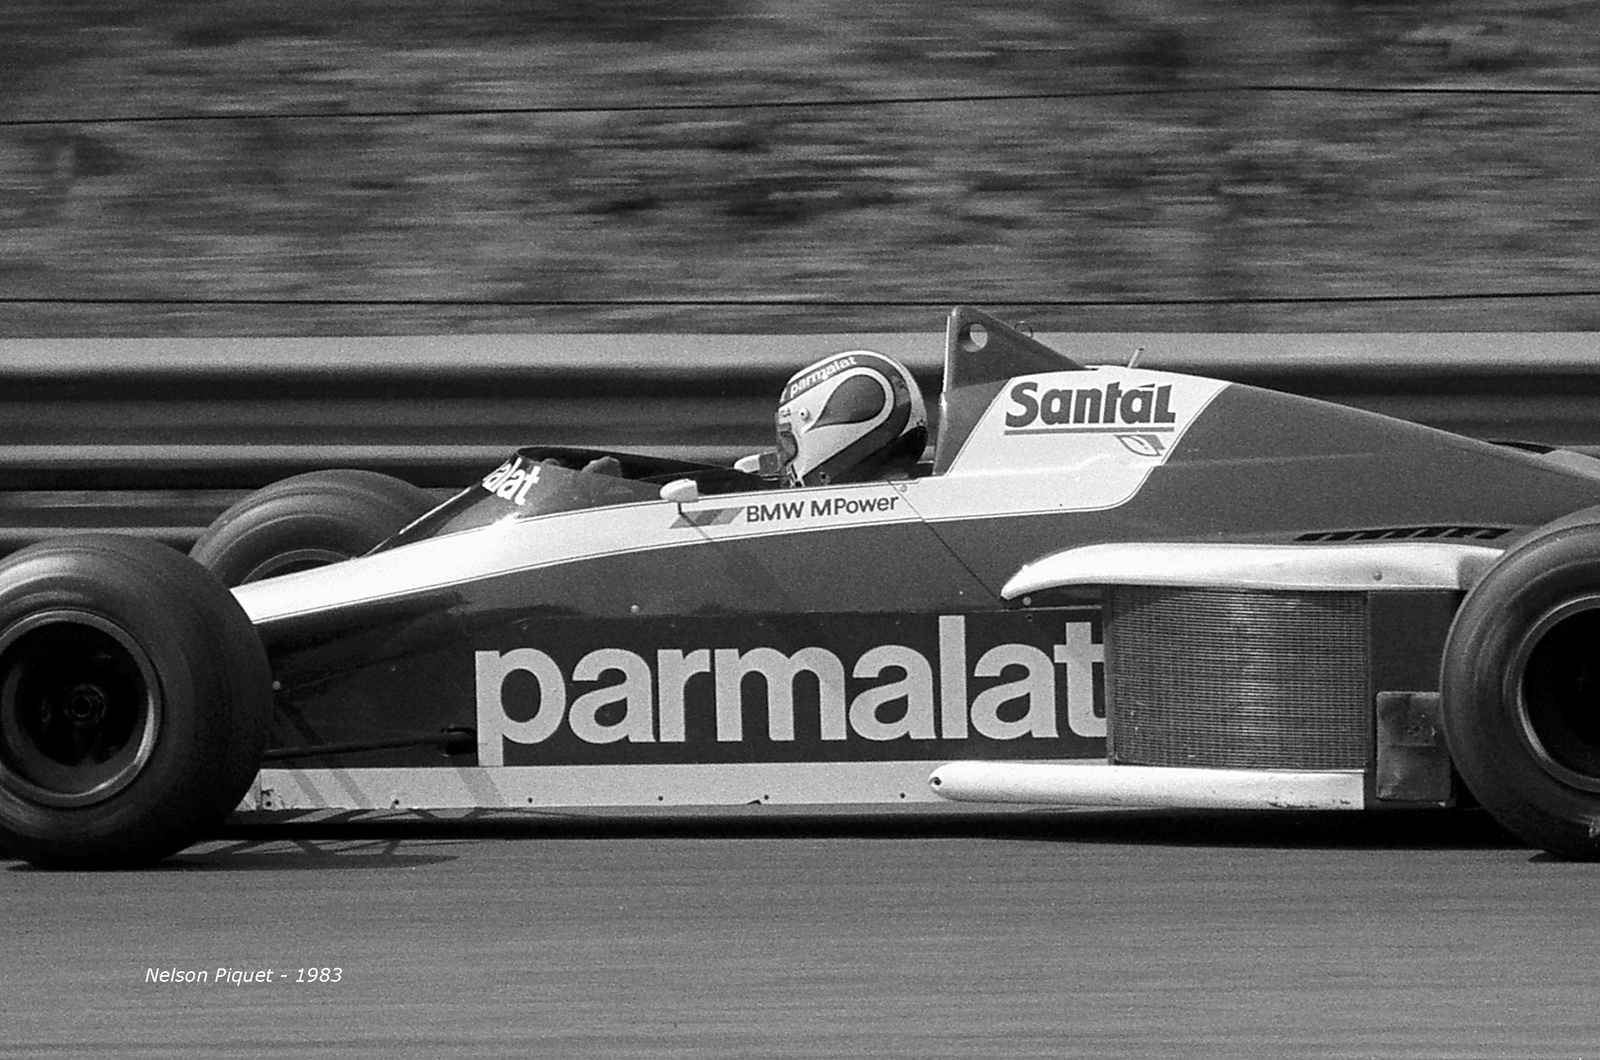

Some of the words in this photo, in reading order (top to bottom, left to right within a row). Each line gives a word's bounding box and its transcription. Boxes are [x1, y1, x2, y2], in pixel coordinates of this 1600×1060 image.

[789, 356, 857, 398] parmalat
[482, 457, 541, 505] alat
[746, 501, 805, 523] BMW
[474, 614, 1107, 767] parmalat
